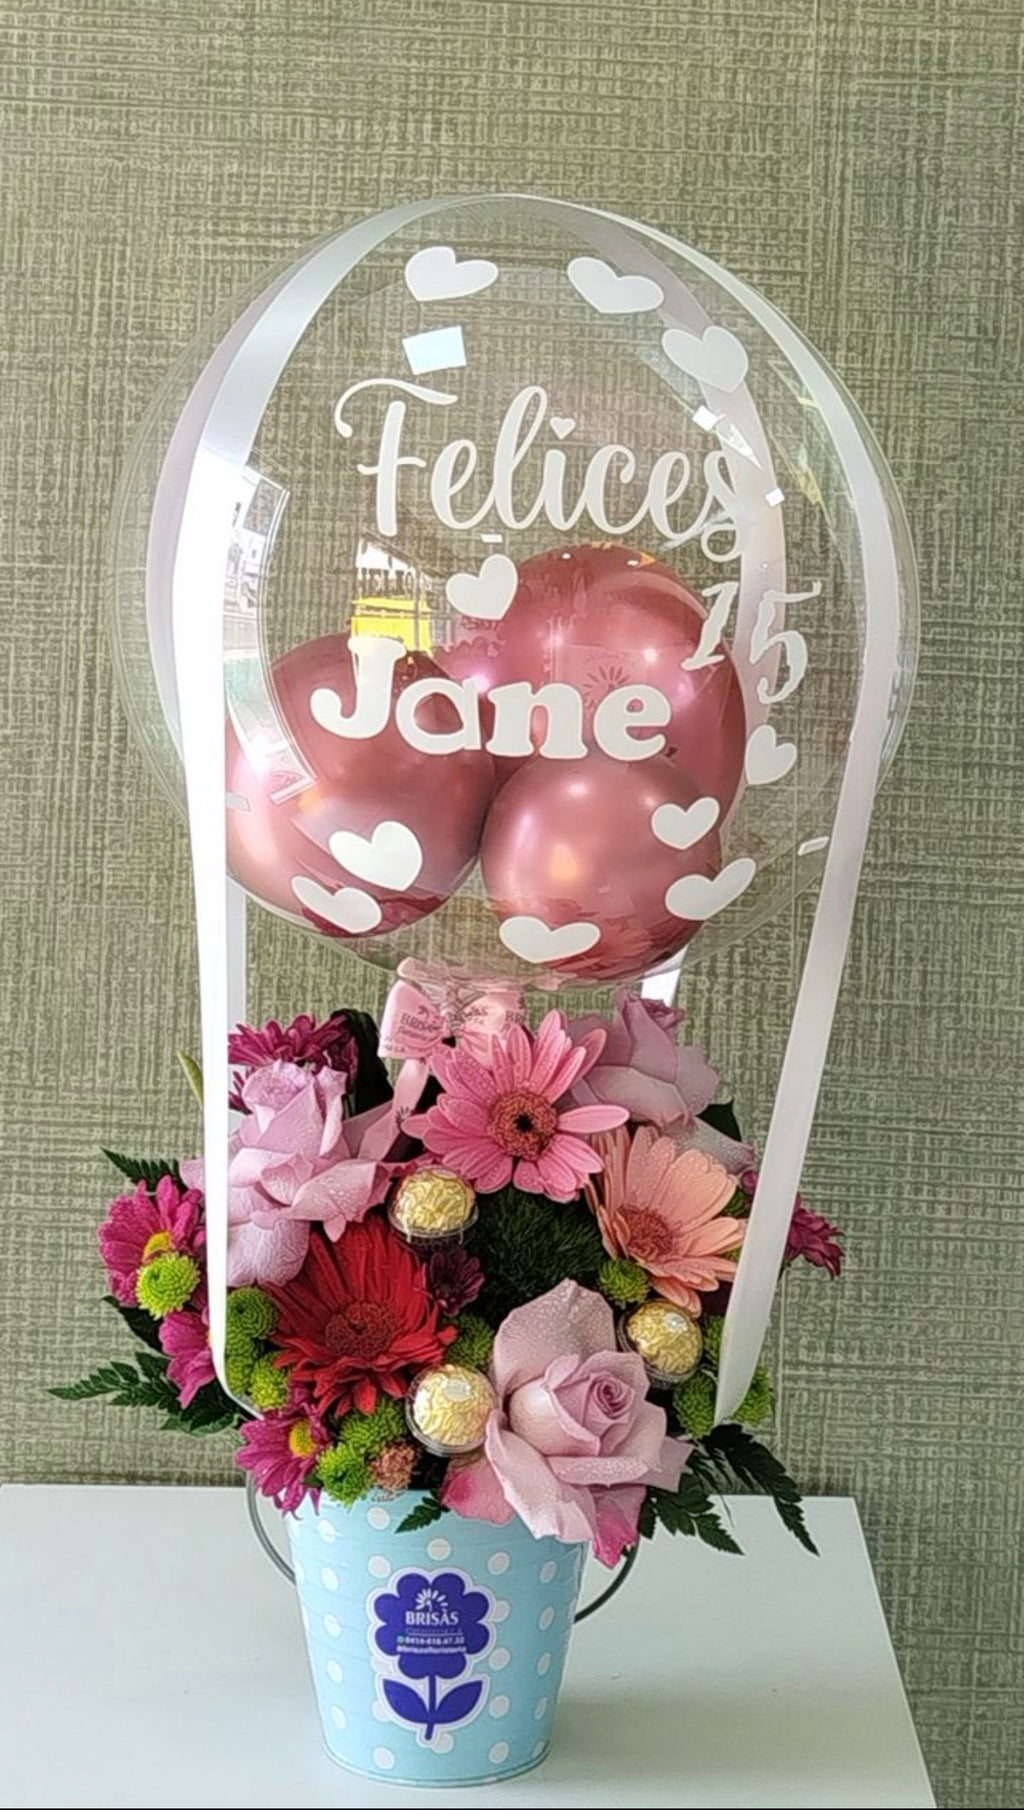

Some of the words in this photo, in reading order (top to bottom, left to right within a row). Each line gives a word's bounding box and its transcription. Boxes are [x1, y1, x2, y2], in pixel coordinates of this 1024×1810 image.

[334, 377, 742, 562] Felices
[310, 636, 672, 761] Jane
[680, 579, 821, 704] 15
